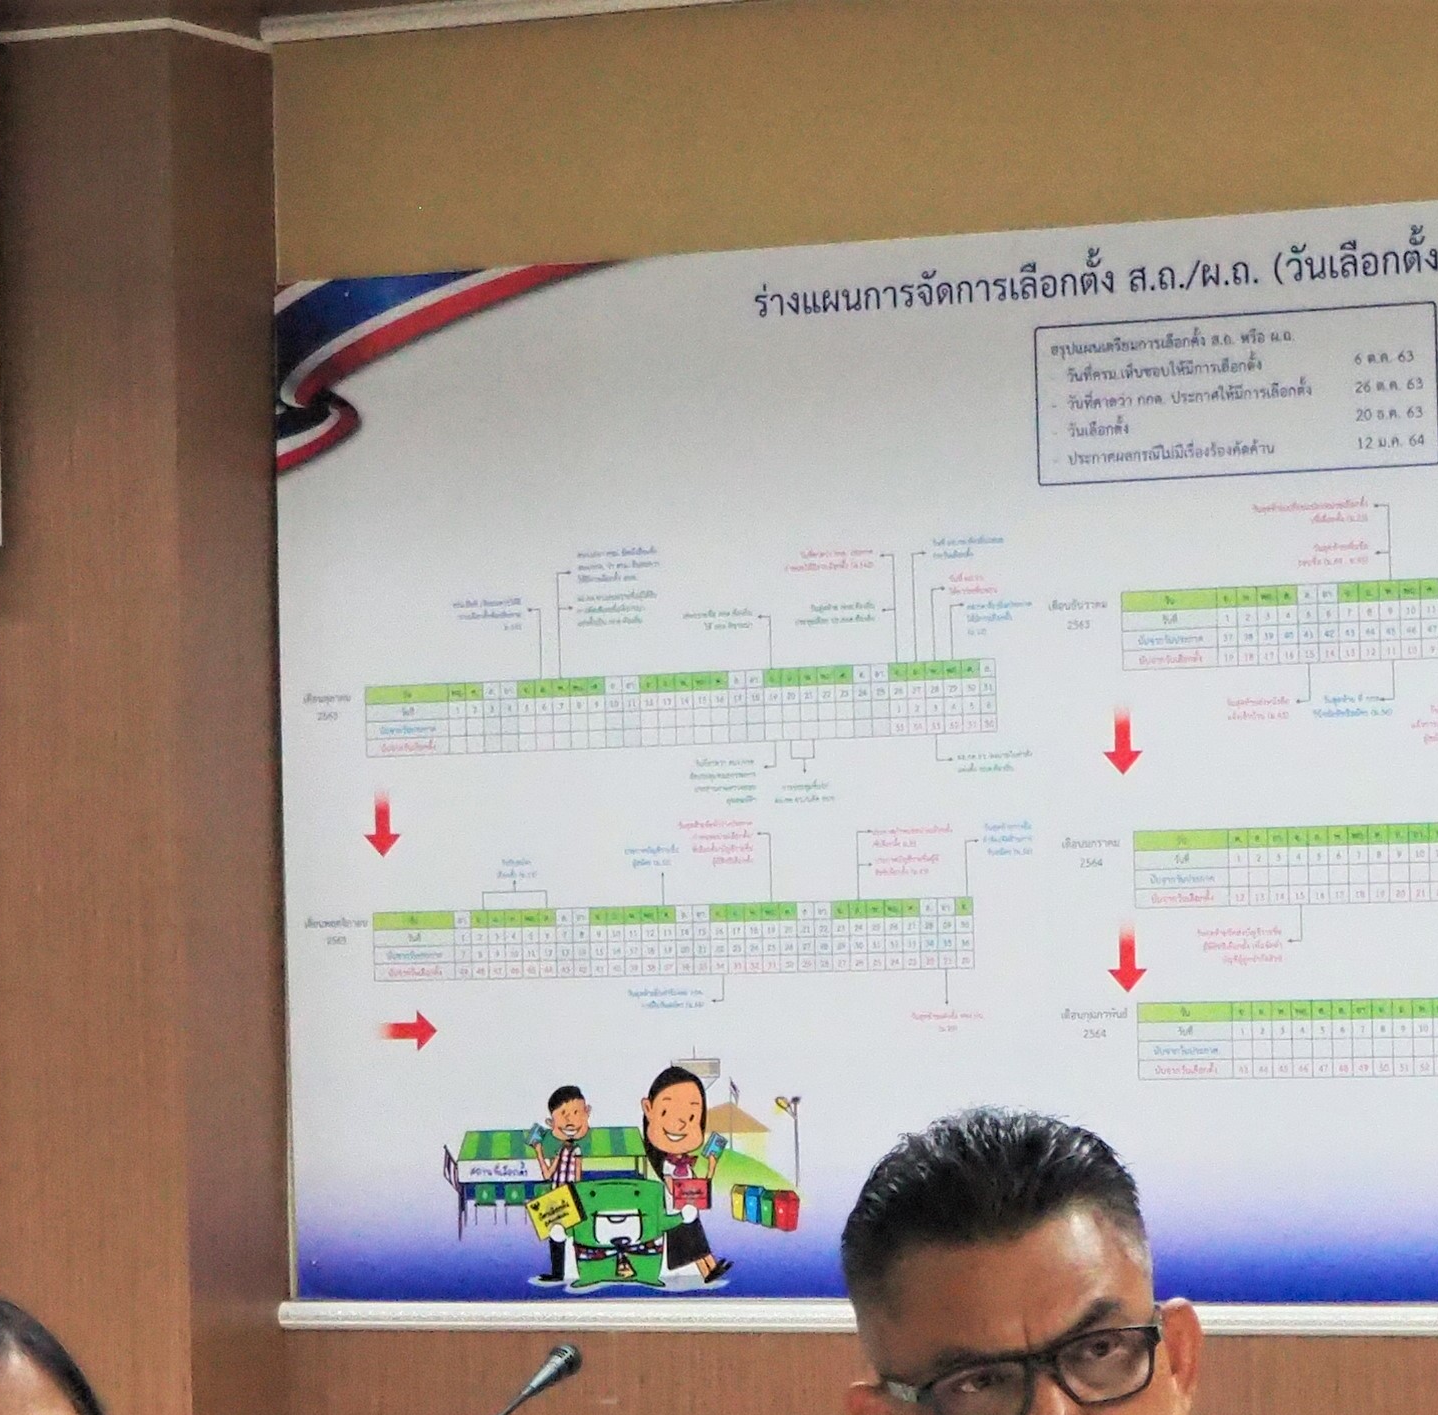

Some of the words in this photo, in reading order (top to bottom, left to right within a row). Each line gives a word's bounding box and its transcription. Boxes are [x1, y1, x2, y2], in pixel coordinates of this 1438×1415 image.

[753, 247, 1115, 319] ร่างแผนการจัดการเลือกตั้ง
[1128, 258, 1259, 294] ส.ถ./ผ.ถ.
[1273, 225, 1438, 285] (วันเลือกตั้ง
[1398, 350, 1414, 363] 63
[1355, 379, 1371, 394] 26
[1407, 377, 1423, 391] 63
[1355, 408, 1372, 423] 20
[1406, 405, 1423, 420] 63
[1357, 436, 1373, 450] 12
[1408, 433, 1425, 447] 64
[1066, 619, 1091, 631] 2563
[1079, 857, 1104, 869] 2564
[1082, 1027, 1107, 1039] 2564
